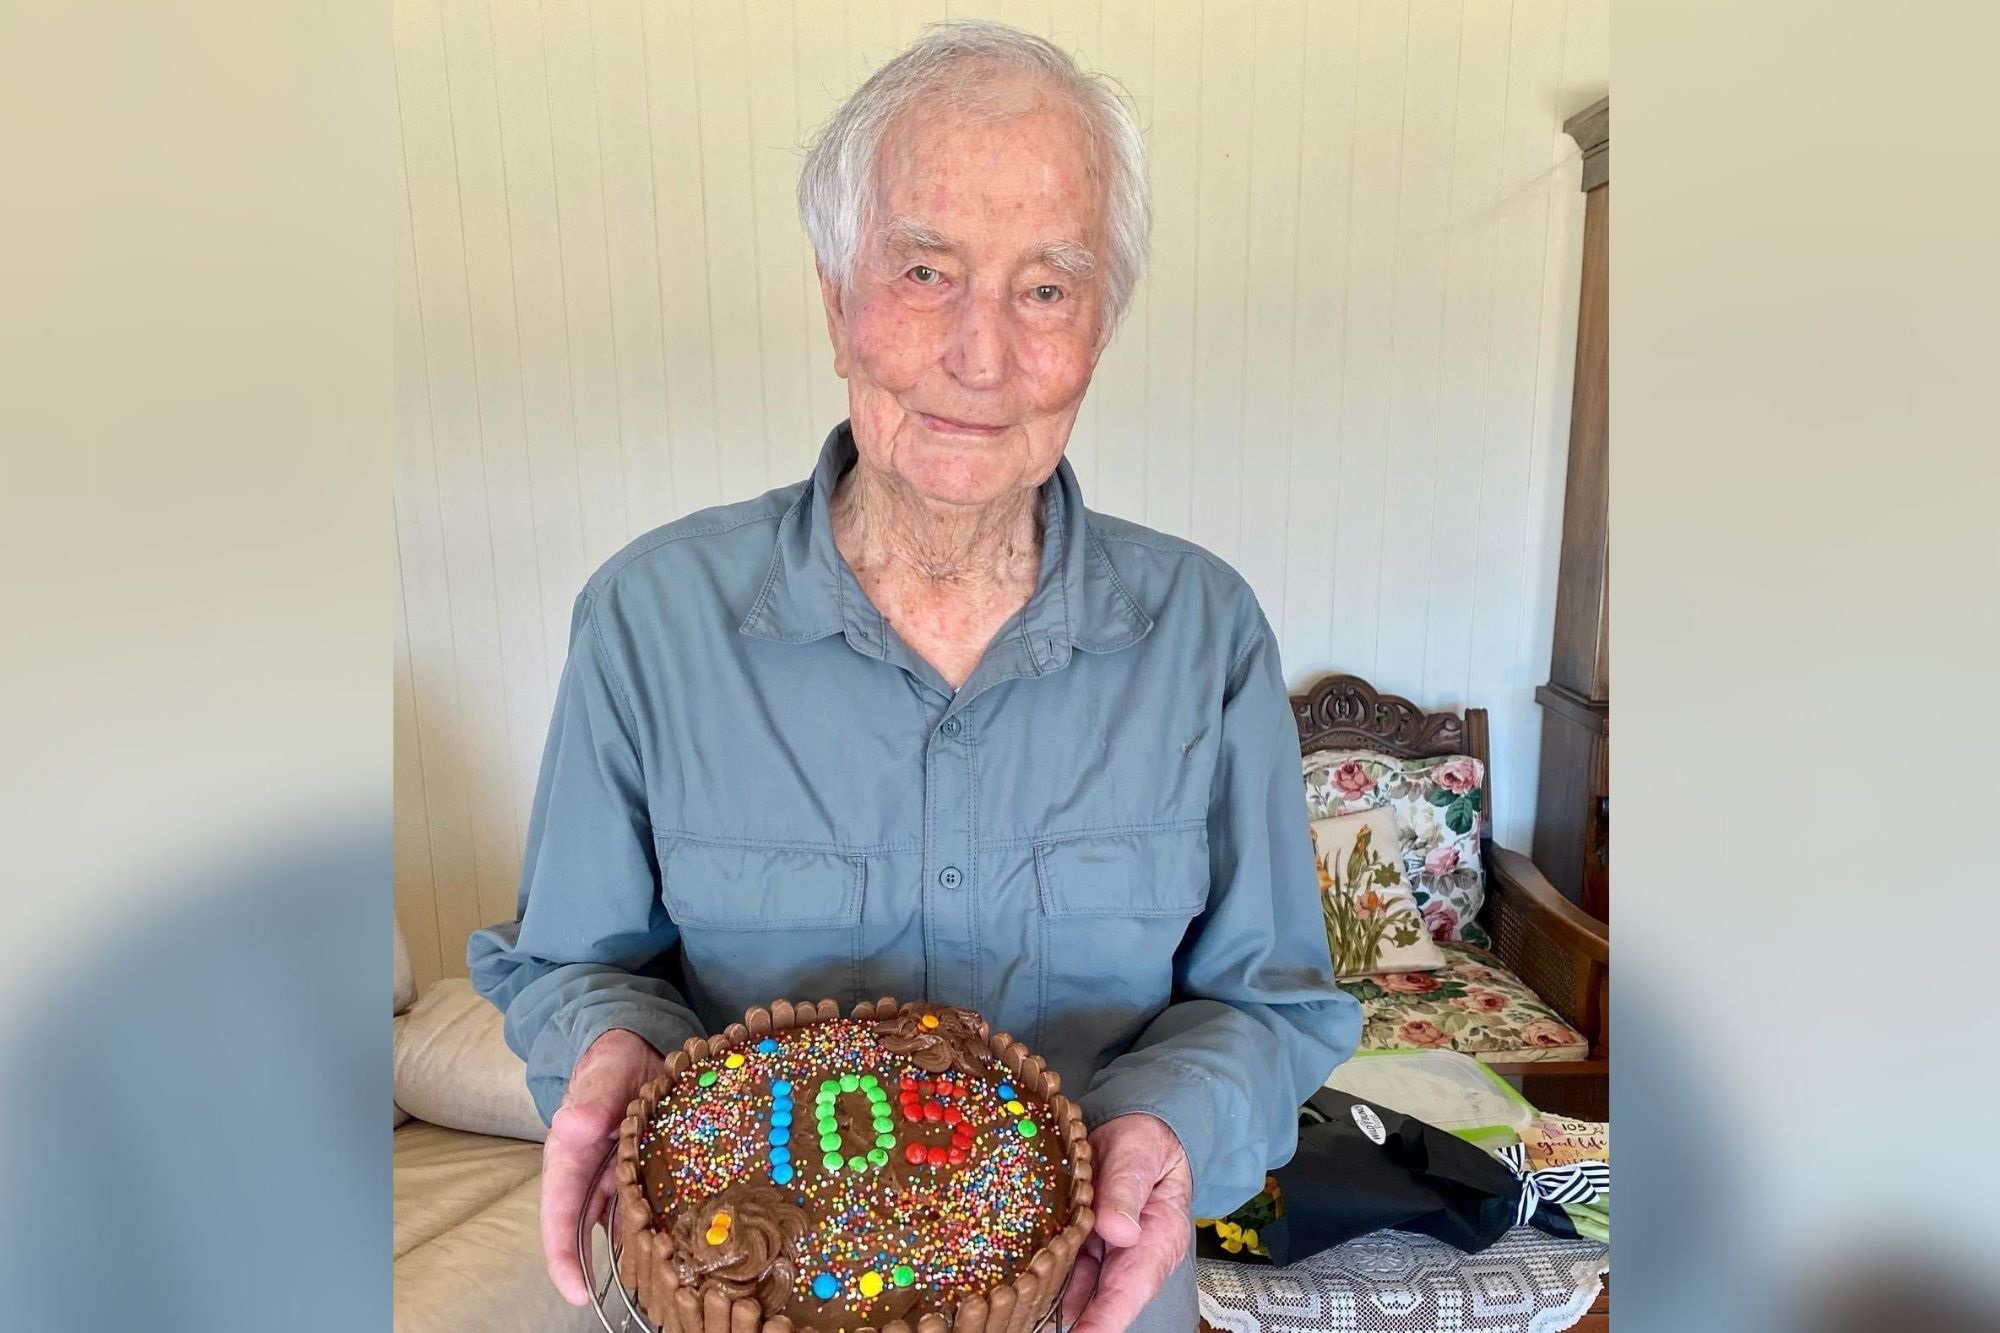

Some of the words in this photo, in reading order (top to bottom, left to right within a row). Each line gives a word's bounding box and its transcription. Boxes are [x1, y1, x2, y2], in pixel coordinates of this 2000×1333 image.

[768, 1074, 976, 1184] 105
[1537, 1138, 1577, 1155] good
[1578, 1137, 1607, 1149] life
